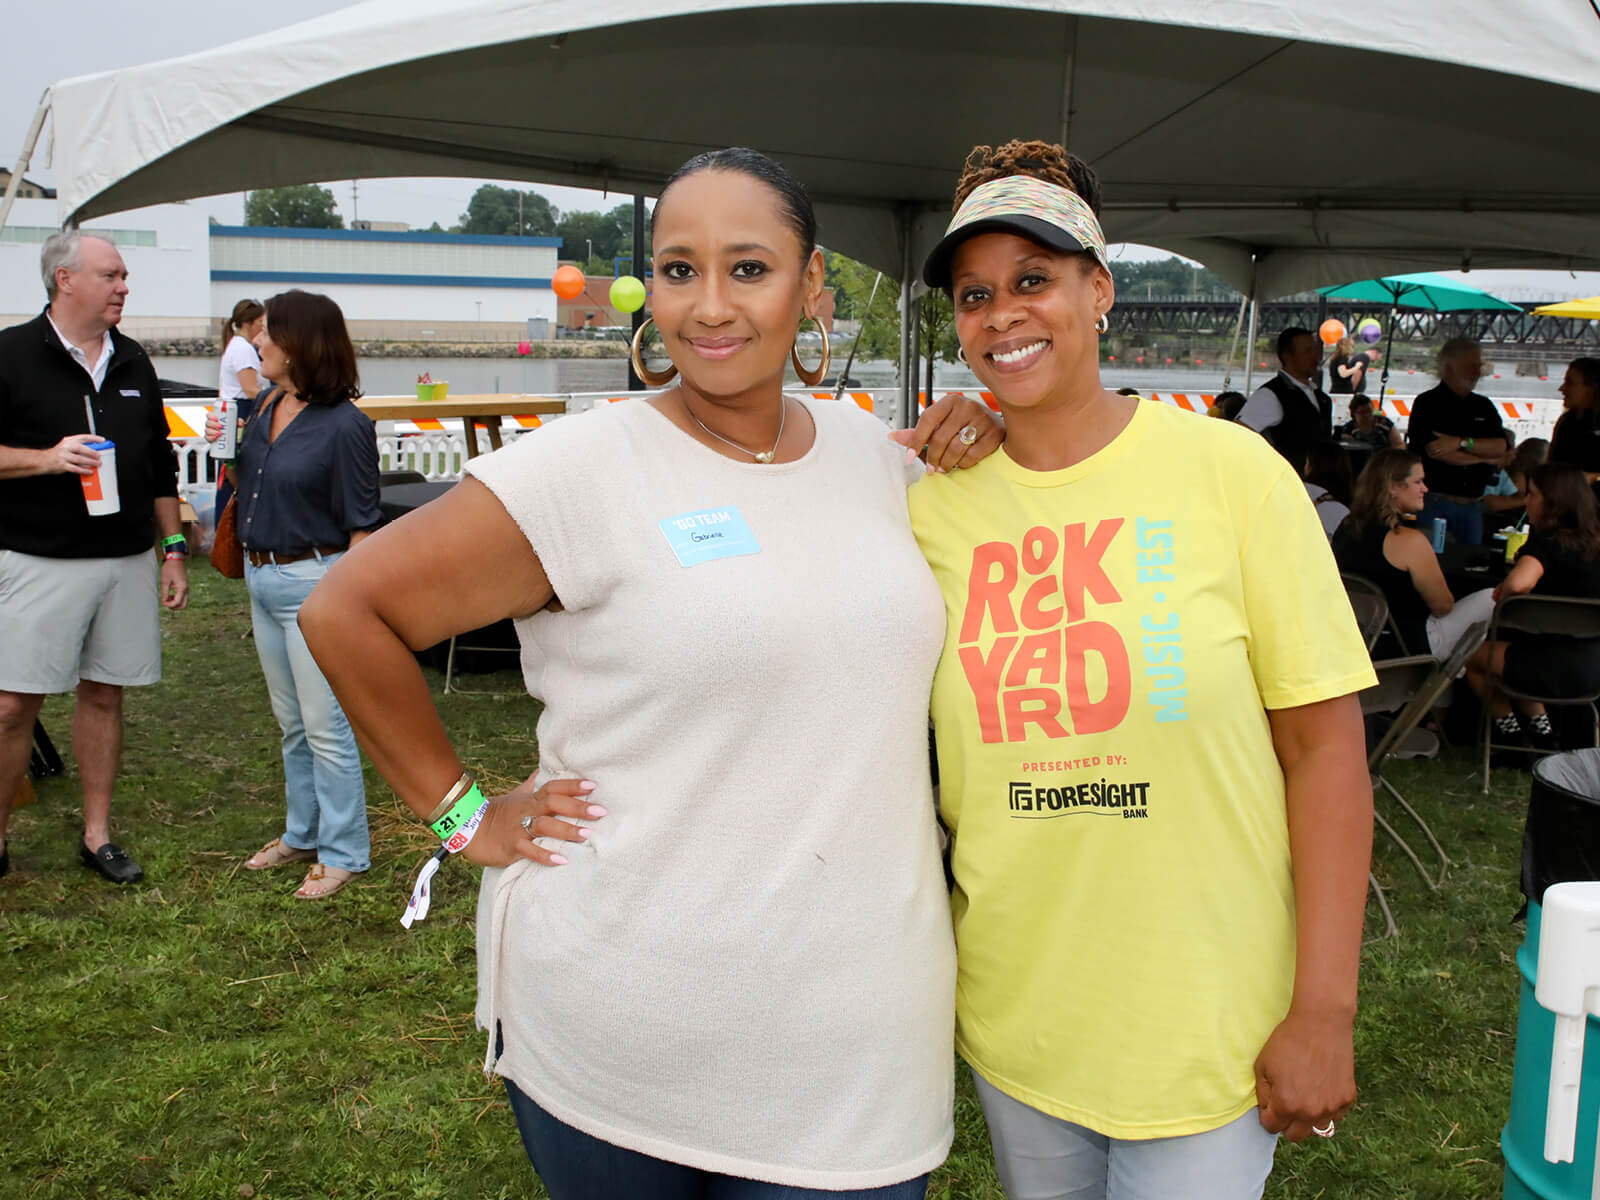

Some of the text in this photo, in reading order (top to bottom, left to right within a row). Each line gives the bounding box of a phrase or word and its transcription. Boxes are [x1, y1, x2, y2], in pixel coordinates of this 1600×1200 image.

[694, 511, 731, 526] TEAM
[1135, 516, 1175, 584] FEST
[959, 517, 1125, 643] ROCK
[958, 621, 1131, 743] YARD
[1022, 755, 1127, 772] PRESENTED BY:
[1123, 809, 1148, 819] BANK
[440, 816, 454, 831] 21
